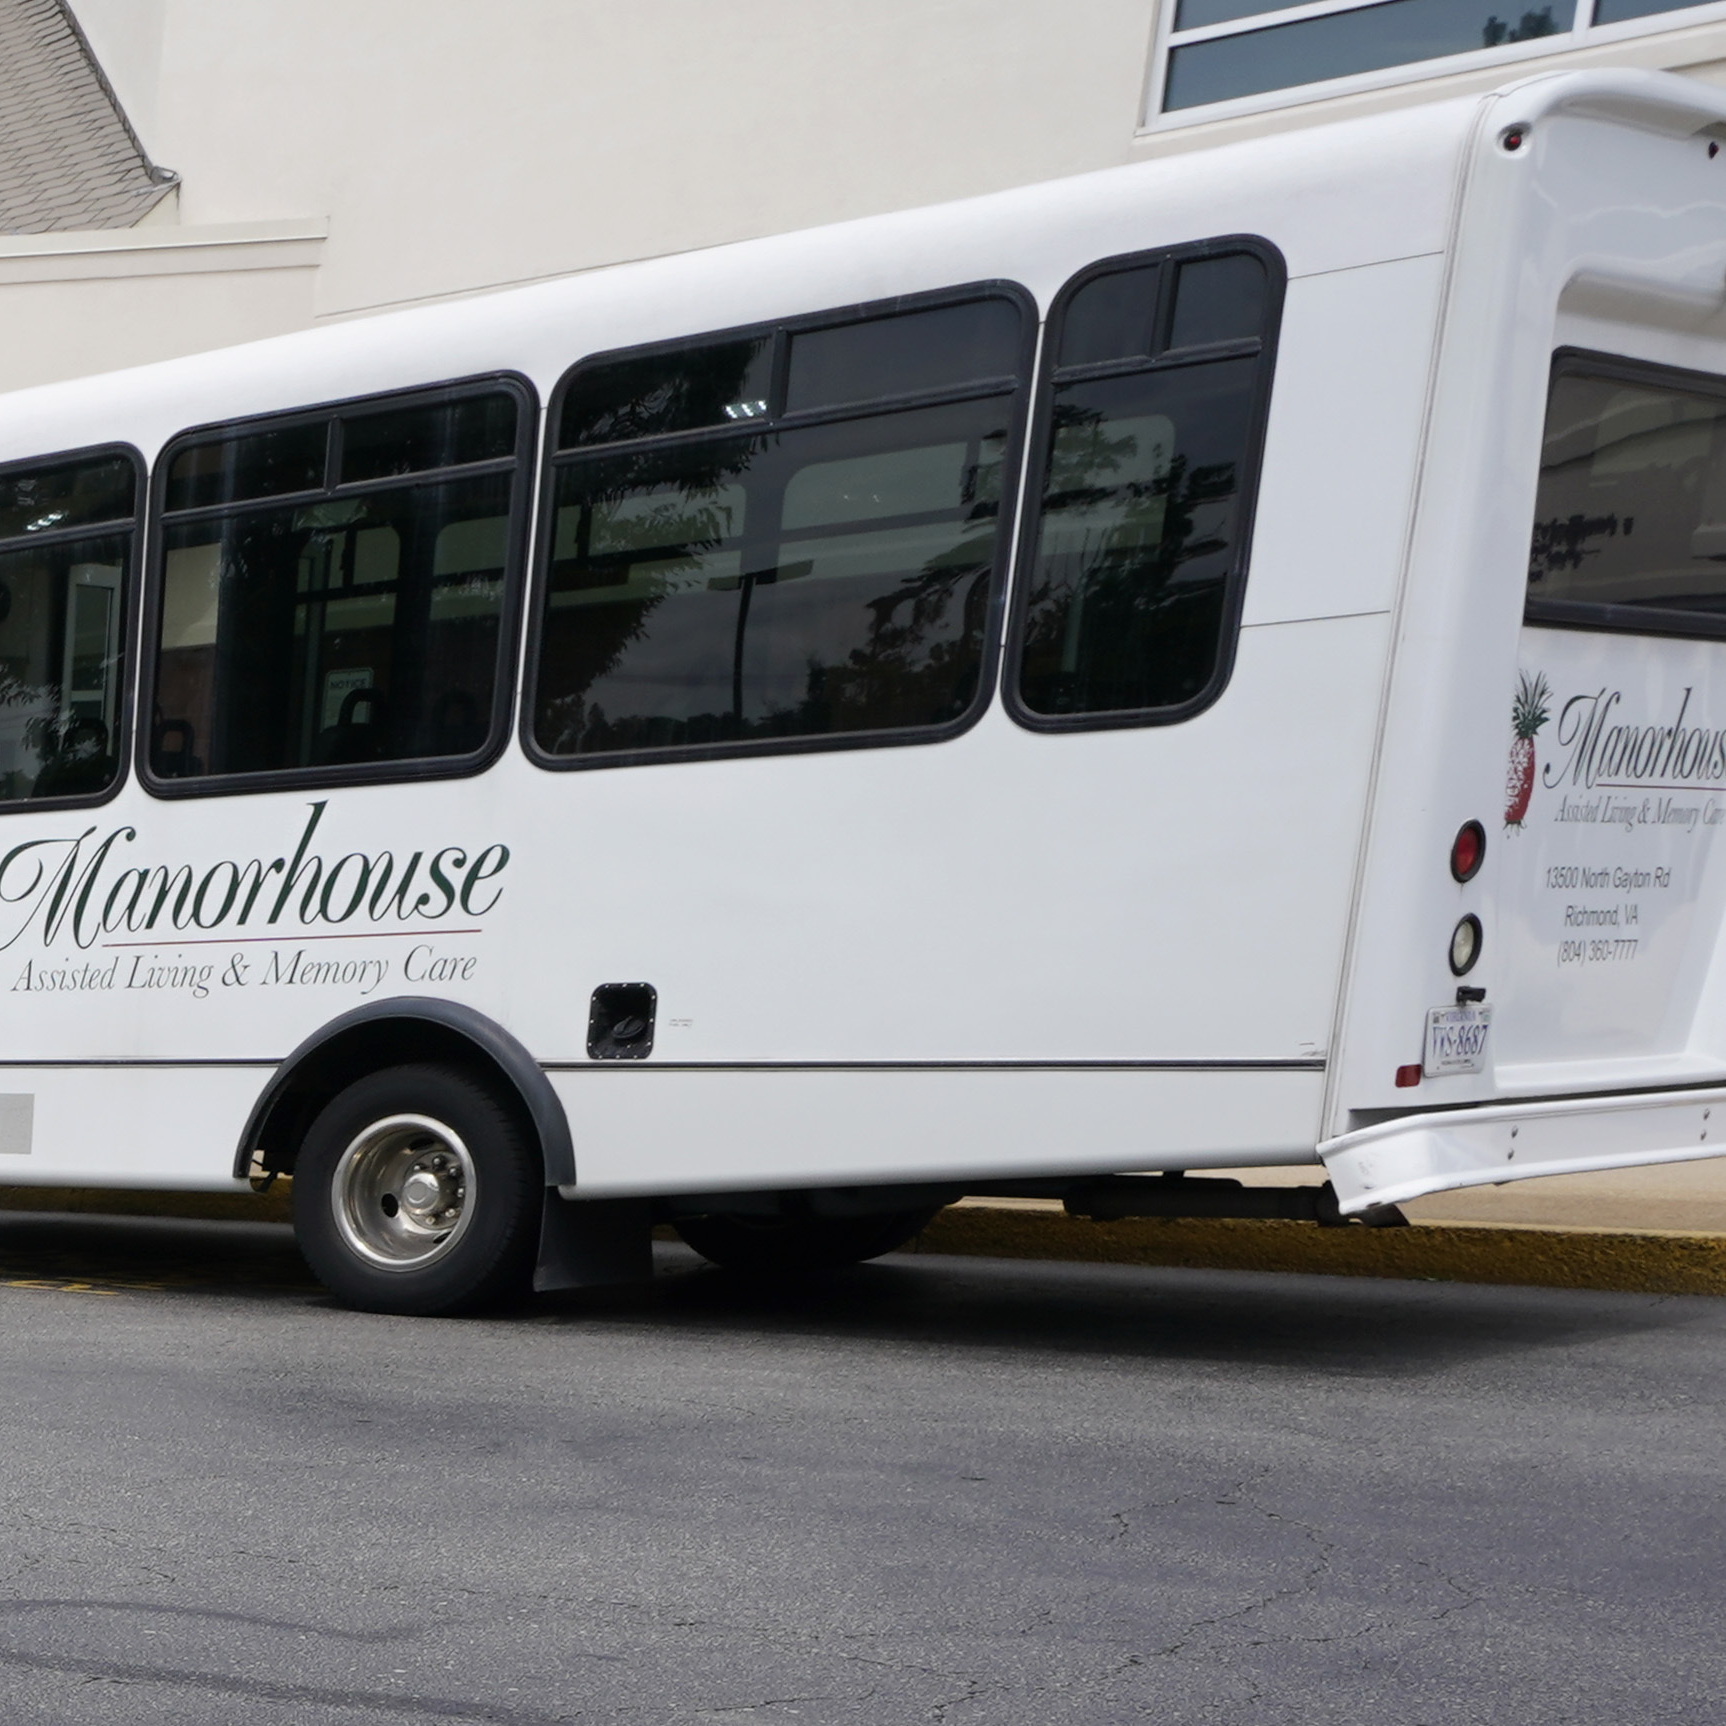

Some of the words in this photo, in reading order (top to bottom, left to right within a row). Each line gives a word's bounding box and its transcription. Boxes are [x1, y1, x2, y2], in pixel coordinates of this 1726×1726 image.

[1542, 686, 1726, 790] Manorhous
[1554, 794, 1601, 823] Assisted
[1601, 796, 1636, 833] Living
[1638, 798, 1650, 824] &
[1651, 797, 1700, 834] Memory
[1546, 866, 1579, 889] 13500
[1581, 866, 1610, 889] North
[1612, 866, 1651, 894] Gayton
[1653, 866, 1672, 888] Rd
[1564, 904, 1620, 928] Richmond,
[1625, 904, 1638, 925] VA
[1557, 939, 1586, 967] (804)
[11, 952, 117, 992] Assisted
[125, 954, 211, 998] Living
[221, 953, 249, 986] &
[261, 948, 390, 995] Memory
[403, 945, 478, 983] Care
